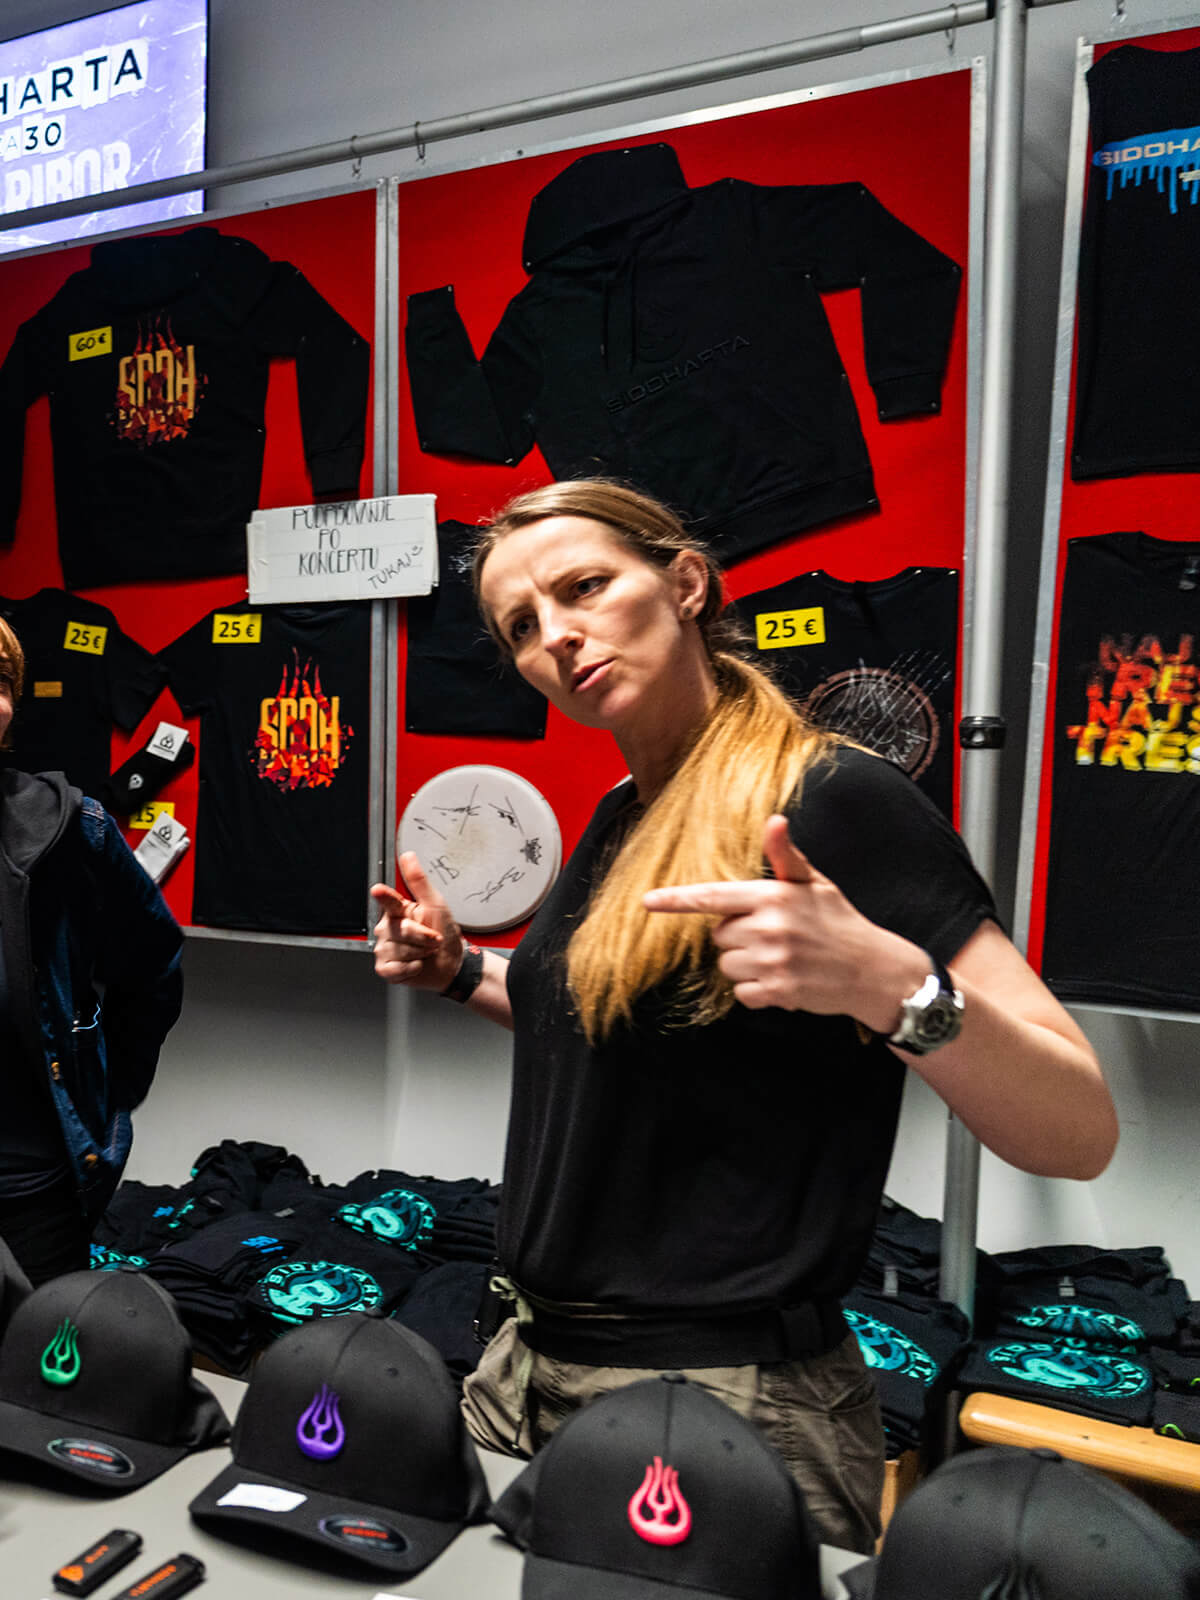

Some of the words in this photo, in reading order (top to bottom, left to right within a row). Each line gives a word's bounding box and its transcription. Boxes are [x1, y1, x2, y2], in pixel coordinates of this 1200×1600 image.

[24, 121, 62, 151] 30
[318, 528, 341, 550] PO
[299, 547, 379, 576] KONCERTU
[368, 552, 412, 589] TUKAJ
[70, 628, 91, 647] 25
[219, 621, 241, 638] 25
[765, 618, 797, 640] 25
